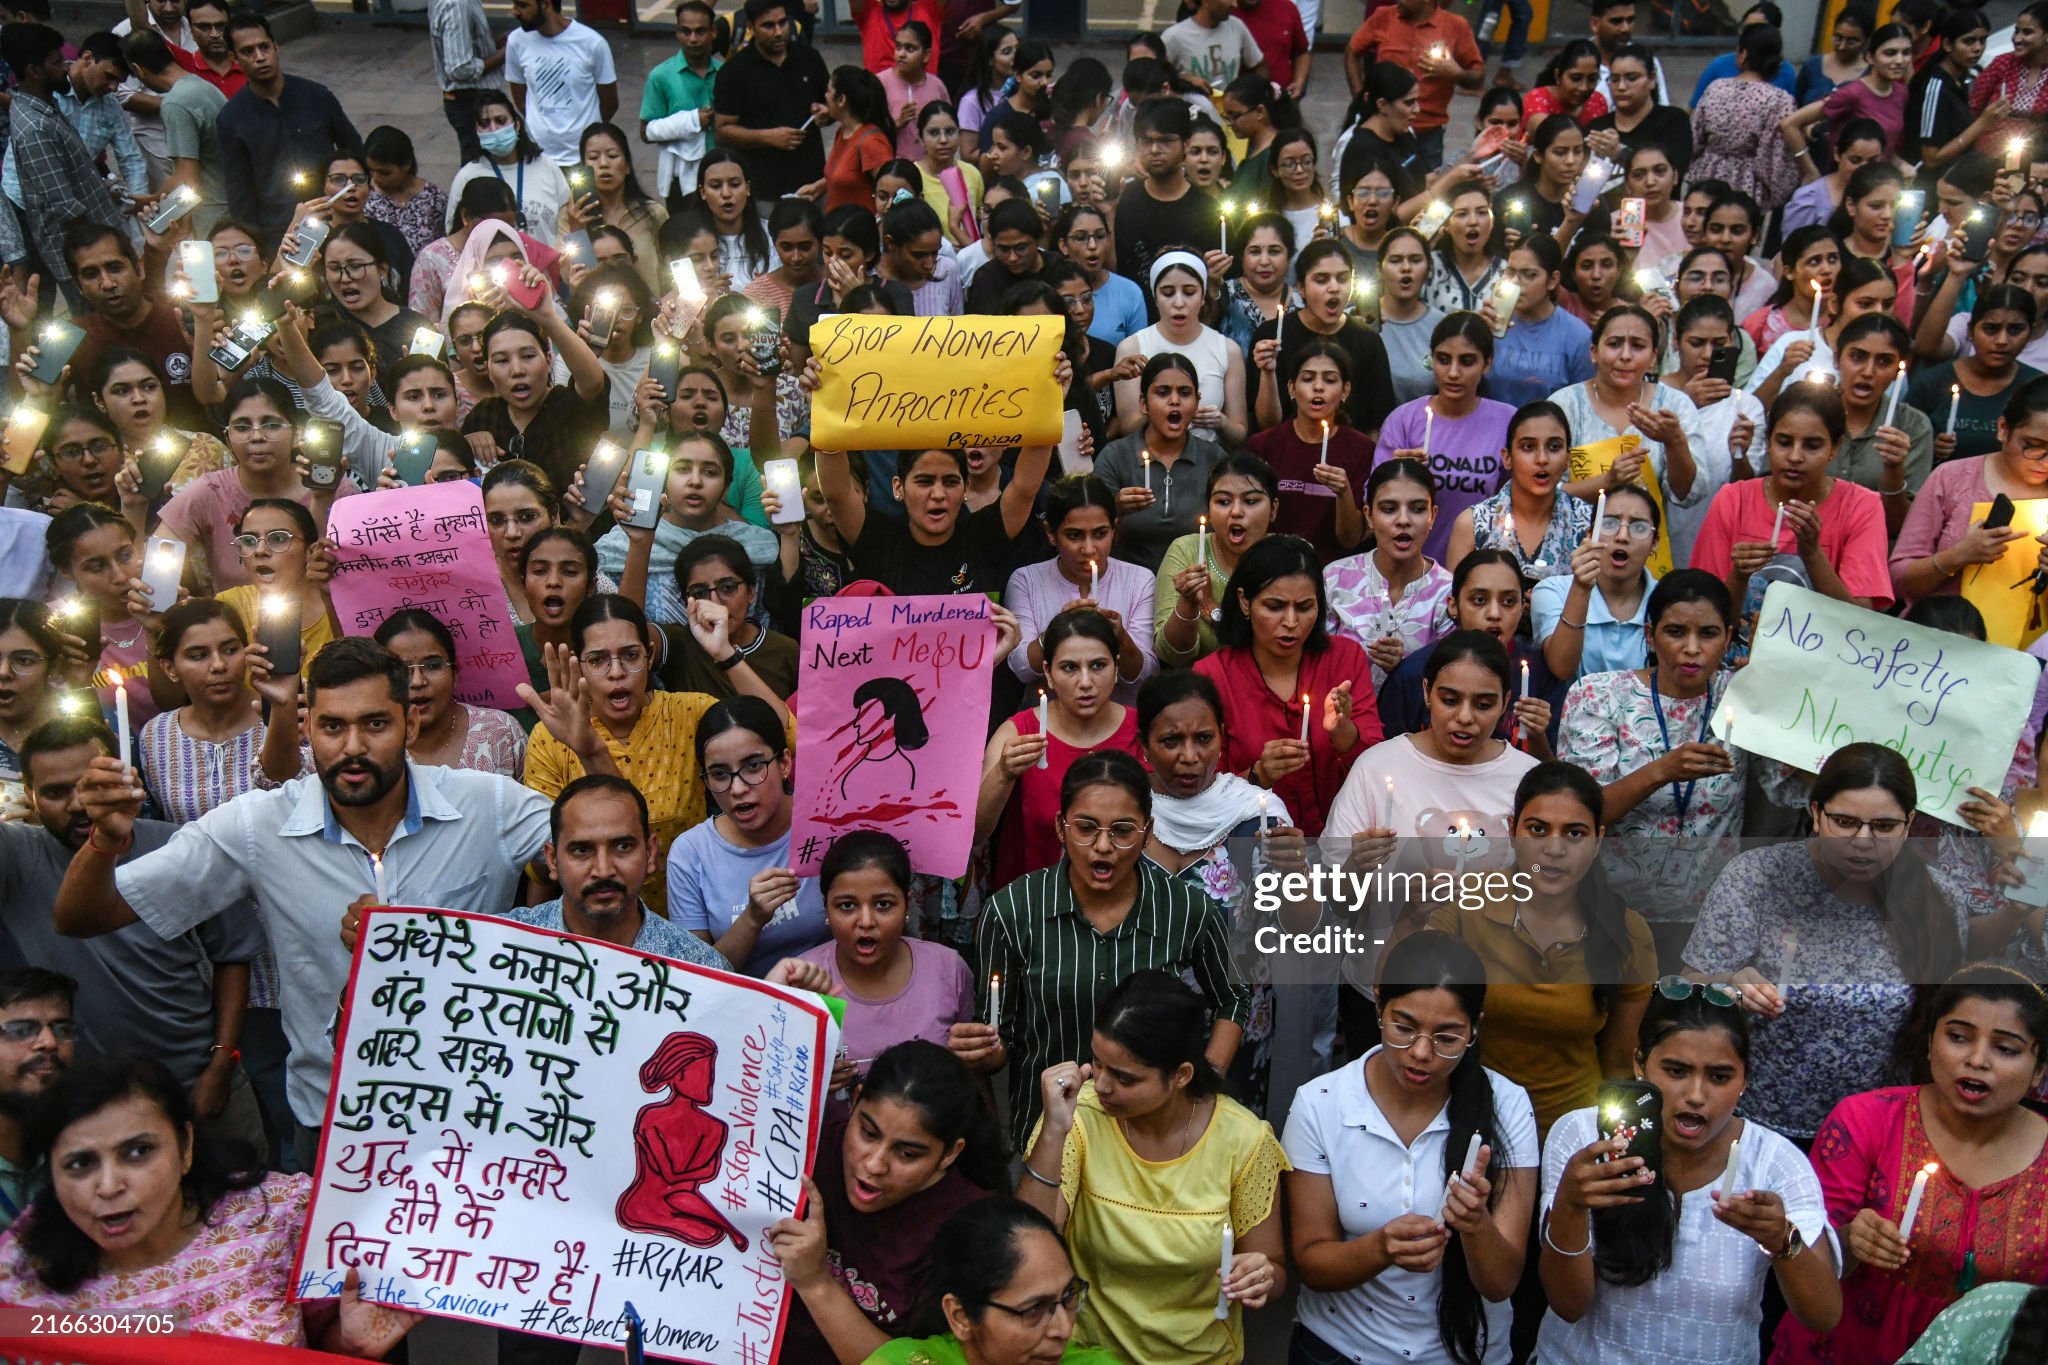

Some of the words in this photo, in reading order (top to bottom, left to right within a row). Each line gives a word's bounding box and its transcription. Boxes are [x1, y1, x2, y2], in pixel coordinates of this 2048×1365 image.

[822, 317, 902, 365] STOP
[911, 317, 1040, 359] WOMEN
[391, 554, 412, 568] का
[459, 588, 490, 613] को
[479, 614, 499, 639] हो
[810, 604, 872, 637] Raped
[891, 600, 989, 625] Murdered
[809, 641, 873, 670] Next
[1763, 607, 1824, 651] No
[1838, 628, 1968, 726] Safety
[1780, 688, 1854, 746] No
[368, 913, 477, 974] अंधेरे
[489, 937, 599, 1001] कमरों
[608, 958, 692, 1022] और
[371, 971, 427, 1025] बंद
[584, 1001, 620, 1055] से
[357, 1028, 426, 1071] बाहर
[438, 1036, 514, 1081] सड़क
[525, 1049, 584, 1099] पर
[787, 1043, 808, 1112] #RGKAR
[334, 1080, 453, 1135] जुलूस
[464, 1079, 502, 1135] में
[505, 1093, 596, 1157] और
[719, 1023, 767, 1212] #Stop_Violence
[432, 1129, 473, 1183] में
[477, 1148, 570, 1201] तुम्हारे
[757, 1107, 804, 1213] #CPA
[385, 1180, 442, 1235] होने
[455, 1184, 497, 1240] के
[326, 1221, 392, 1270] दिन
[402, 1247, 473, 1286] आ
[612, 1239, 723, 1292] #RGKAR
[294, 1269, 508, 1318] #Sae_the_Saviour
